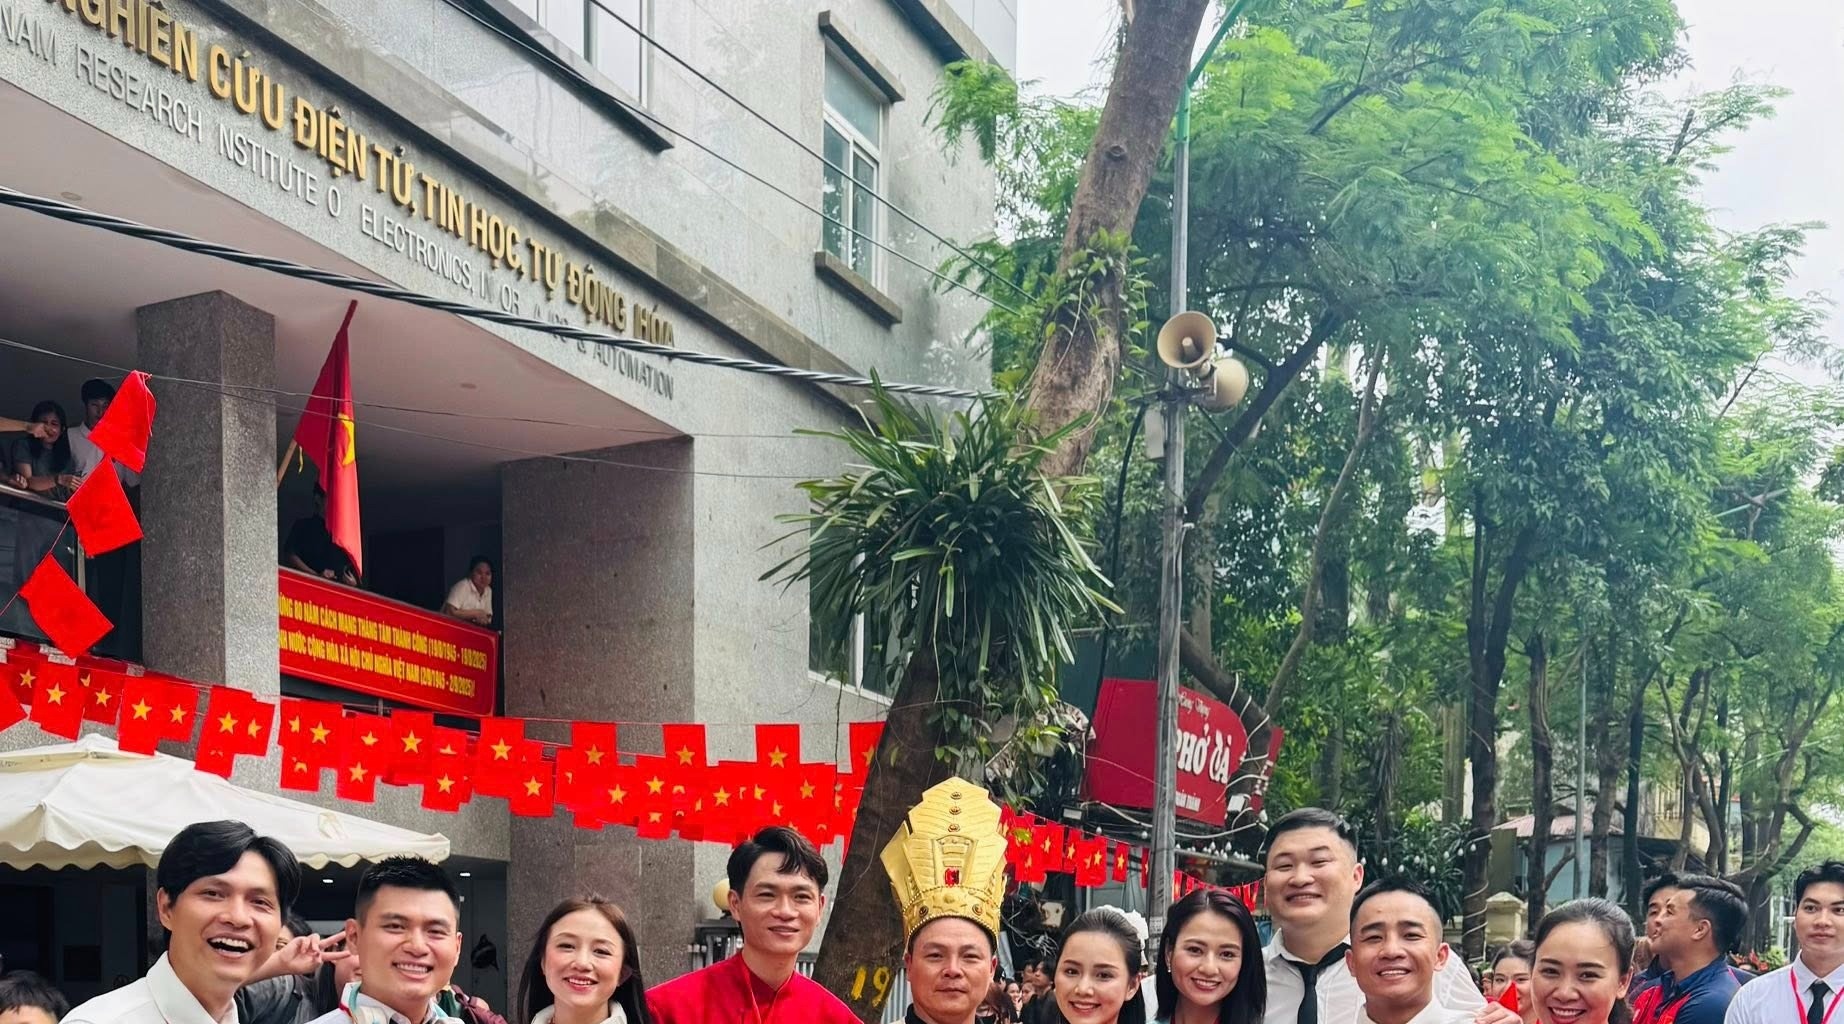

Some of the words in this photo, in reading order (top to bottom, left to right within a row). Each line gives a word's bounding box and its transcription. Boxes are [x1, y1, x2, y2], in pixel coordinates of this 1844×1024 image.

[60, 0, 198, 82] GHIÊN
[208, 44, 285, 130] CỨU
[292, 95, 366, 182] ĐIỆN
[418, 173, 464, 238] TIN
[468, 202, 526, 277] HỌC,
[525, 237, 562, 301] TỰ
[565, 262, 627, 332] ĐỘNG
[75, 43, 203, 143] RESEARCH
[361, 203, 474, 295] ELECTRONICS,
[592, 341, 675, 401] AUTOMATION
[320, 604, 337, 630] CÁCH
[338, 612, 357, 637] MẠNG
[357, 615, 378, 641] THÁNG
[378, 620, 391, 645] TÁM
[392, 625, 411, 650] THÀNH
[412, 630, 427, 655] CÔNG
[288, 630, 306, 655] NƯỚC
[307, 633, 325, 661] CỘNG
[340, 642, 349, 666] XÃ
[350, 644, 361, 672] HỘI
[361, 646, 373, 672] CHỦ
[393, 656, 405, 683] VIỆT
[405, 662, 419, 684] NAM
[851, 966, 890, 1008] 19
